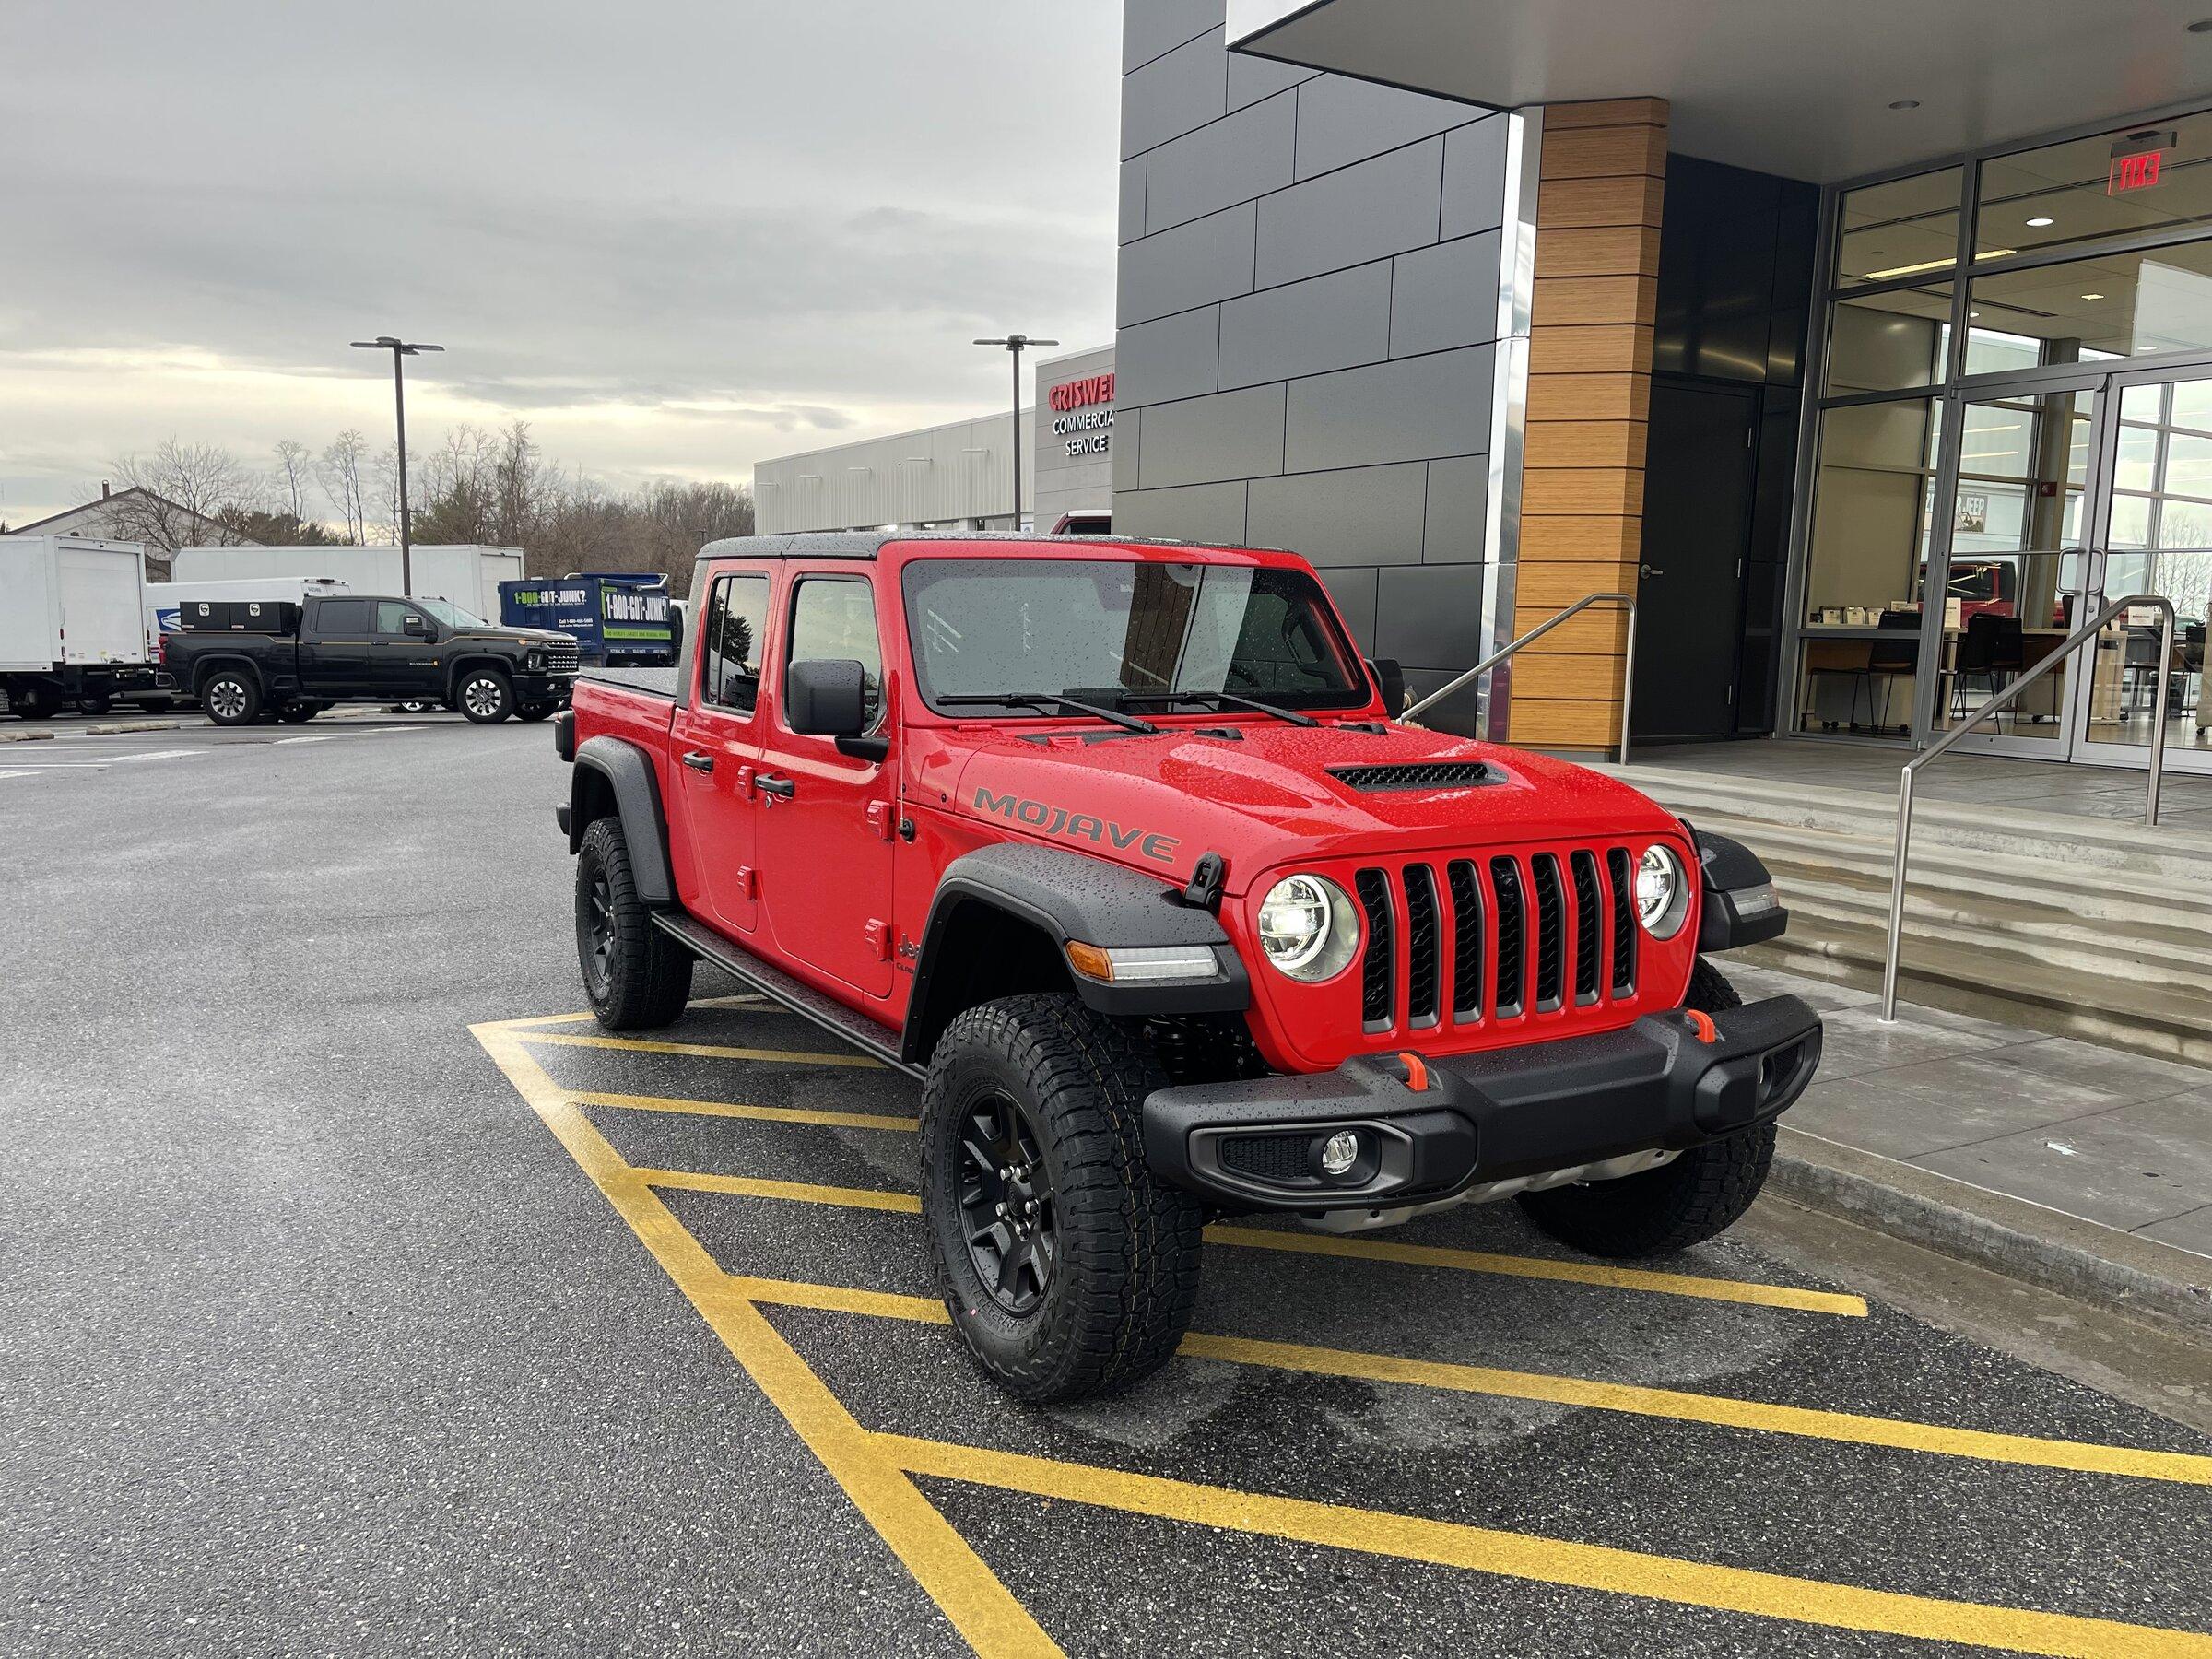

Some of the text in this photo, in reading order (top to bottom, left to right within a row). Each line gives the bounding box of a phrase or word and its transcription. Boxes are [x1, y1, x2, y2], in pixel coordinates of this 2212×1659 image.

[1048, 372, 1114, 412] CRISWEL
[1053, 409, 1114, 435] COMMERCIA
[1065, 434, 1107, 456] SERVICE
[606, 594, 667, 621] 1-800-GOT-JUNK?
[973, 786, 1182, 865] MOJAVE
